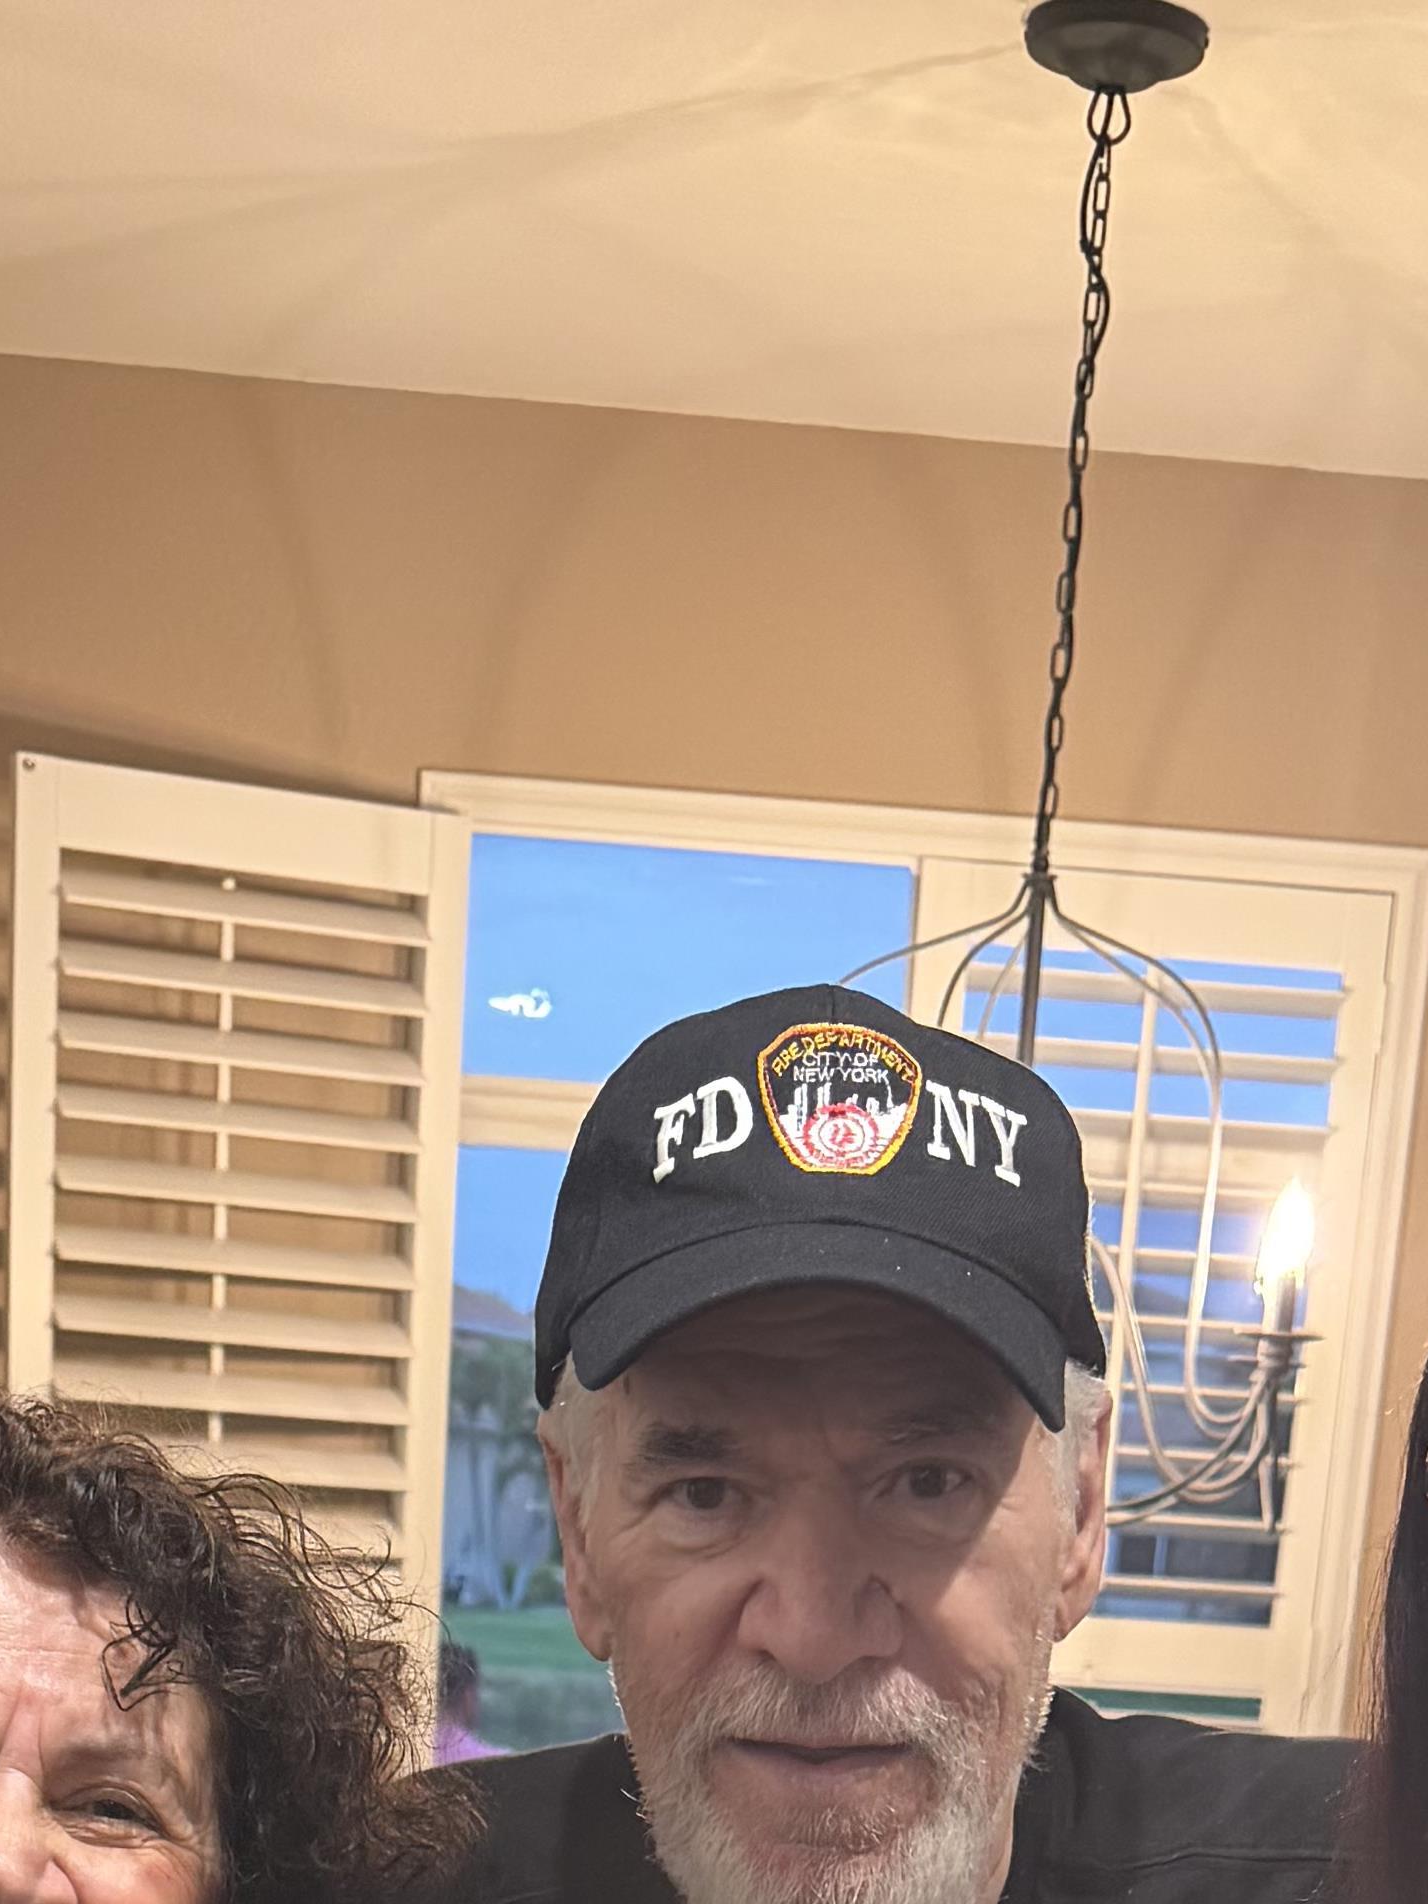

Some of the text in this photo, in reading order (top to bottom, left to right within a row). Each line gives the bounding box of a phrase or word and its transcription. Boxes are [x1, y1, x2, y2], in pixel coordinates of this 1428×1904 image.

[772, 1031, 916, 1084] FIRE DEPARTMENT
[793, 1065, 889, 1084] NEW YORK
[802, 1051, 879, 1068] CITY OF
[652, 1076, 1028, 1188] FD NY
